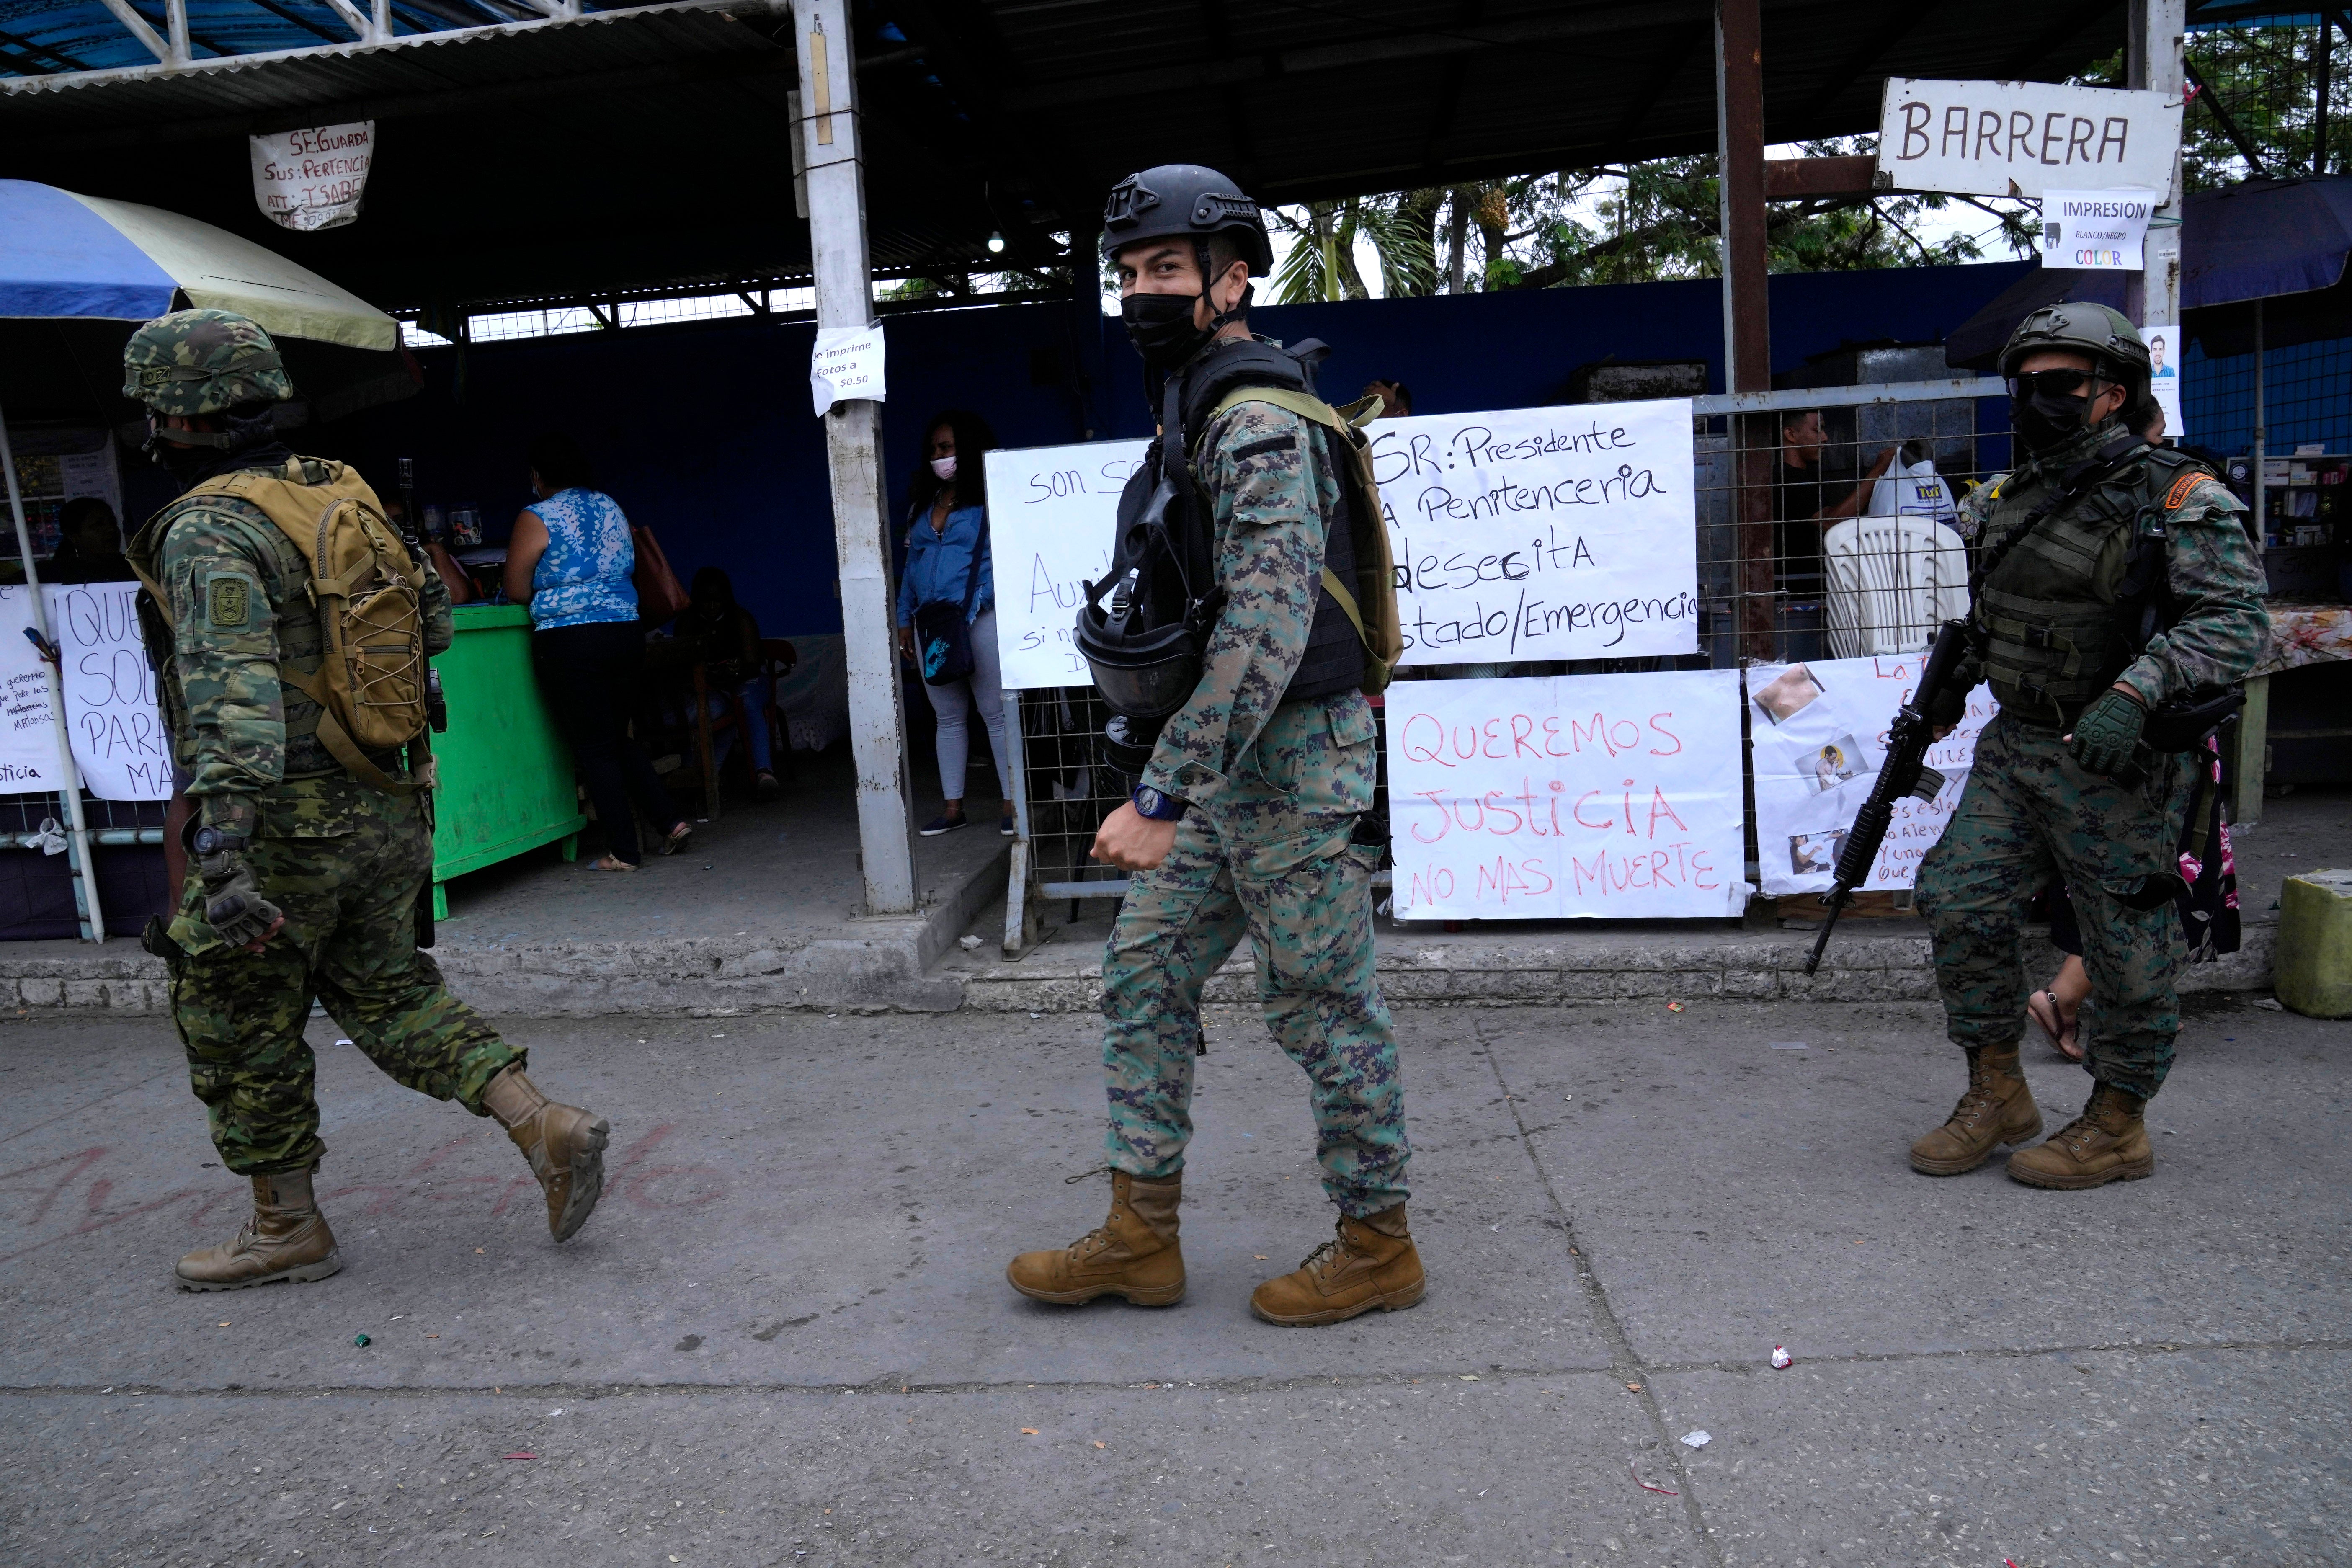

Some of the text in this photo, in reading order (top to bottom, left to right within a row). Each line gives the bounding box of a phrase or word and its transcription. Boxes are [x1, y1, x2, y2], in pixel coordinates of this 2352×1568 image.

[1896, 101, 2128, 165] BARRERA
[2064, 201, 2146, 218] IMPRESIÓN
[2076, 230, 2126, 240] BLANCO/NEGRO
[2076, 250, 2122, 265] COLOR
[826, 342, 872, 359] imprime
[817, 364, 846, 379] Fotos
[840, 375, 868, 388] $0.50
[1452, 420, 1636, 468] Presidente
[2171, 479, 2191, 505] INFANTERIA
[1403, 712, 1681, 767] QUEREMOS
[1411, 841, 1720, 906] NO MAS MUERTE
